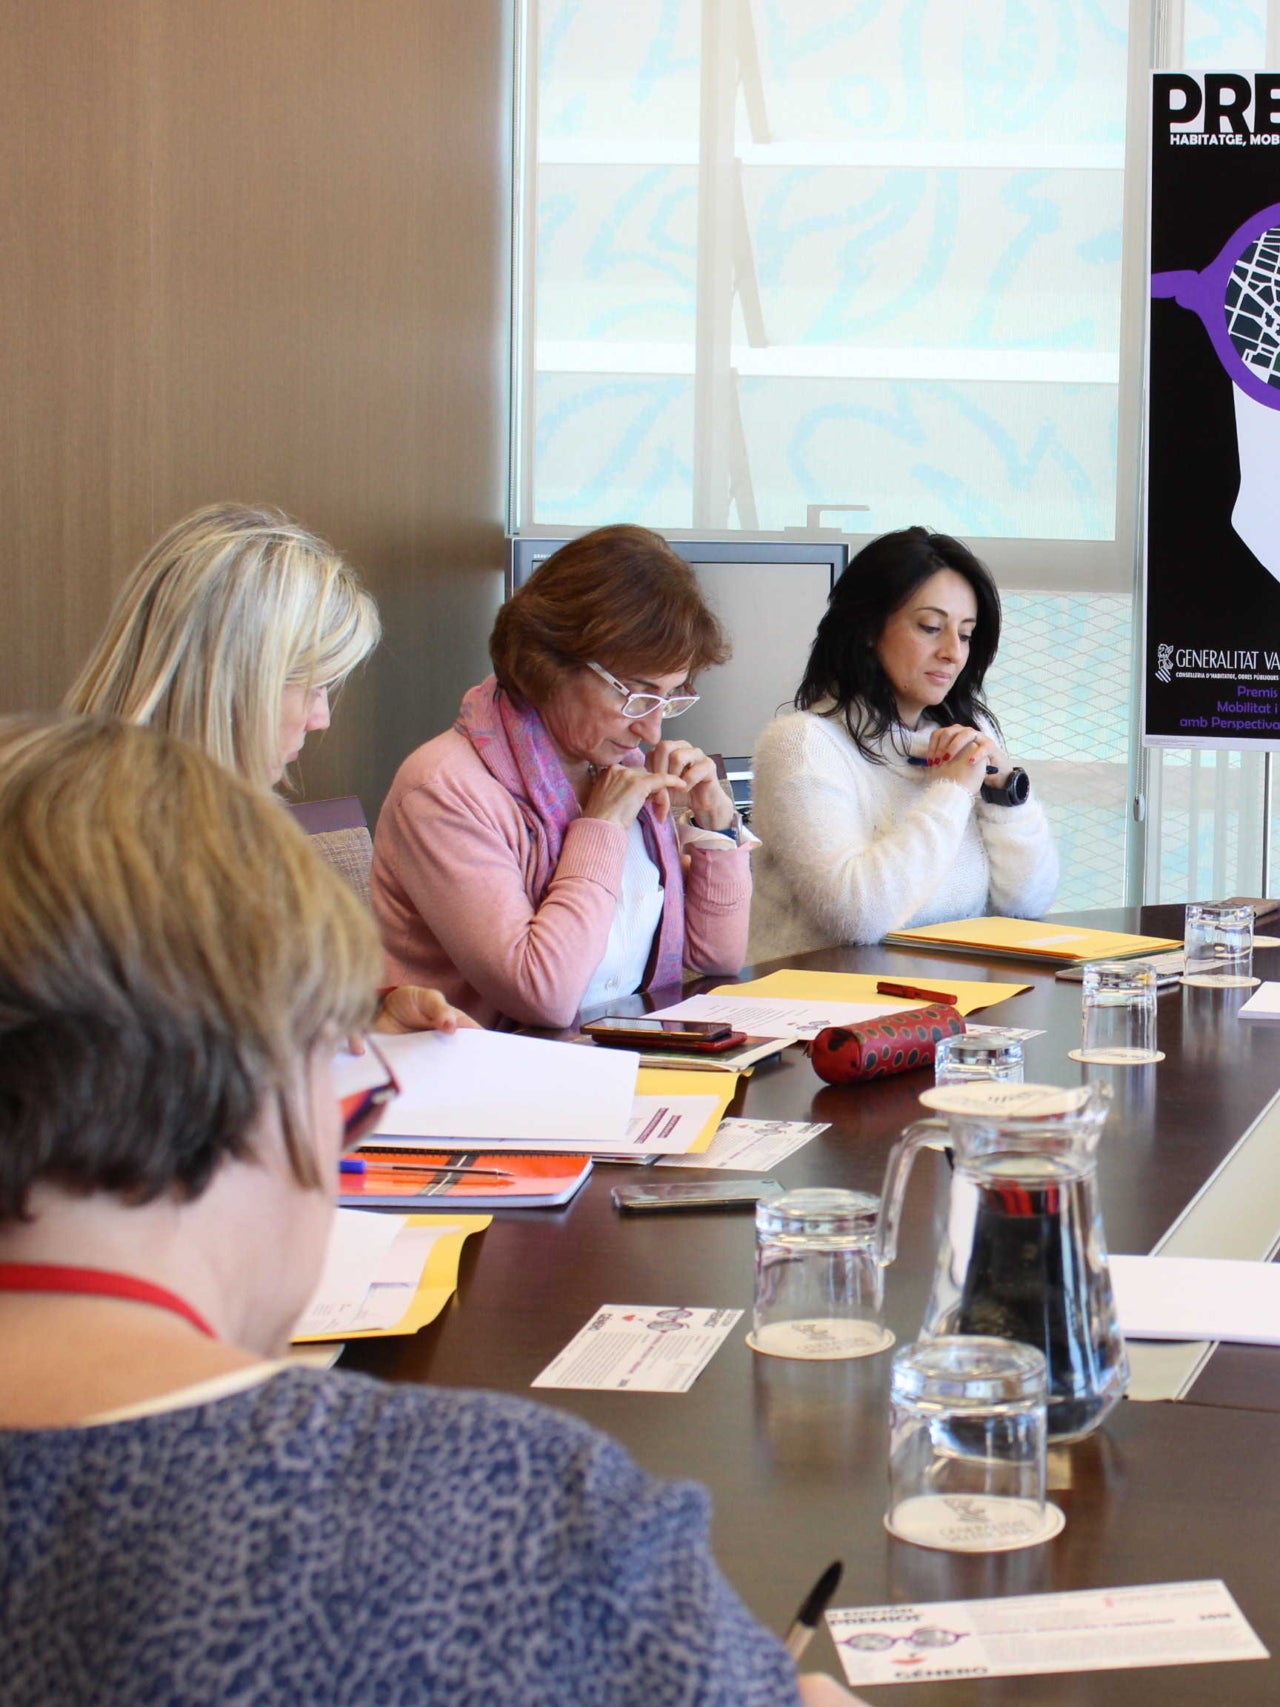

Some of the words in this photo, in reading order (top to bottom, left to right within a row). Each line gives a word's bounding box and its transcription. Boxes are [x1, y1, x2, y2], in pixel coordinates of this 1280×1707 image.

[1170, 134, 1247, 147] HABITATGE,
[1176, 648, 1260, 671] GENERALITAT
[1237, 685, 1278, 698] Premis
[1217, 701, 1271, 714] Mobilitat
[1274, 703, 1278, 714] i
[1180, 717, 1208, 728] amb
[1211, 716, 1280, 731] Perspectiva
